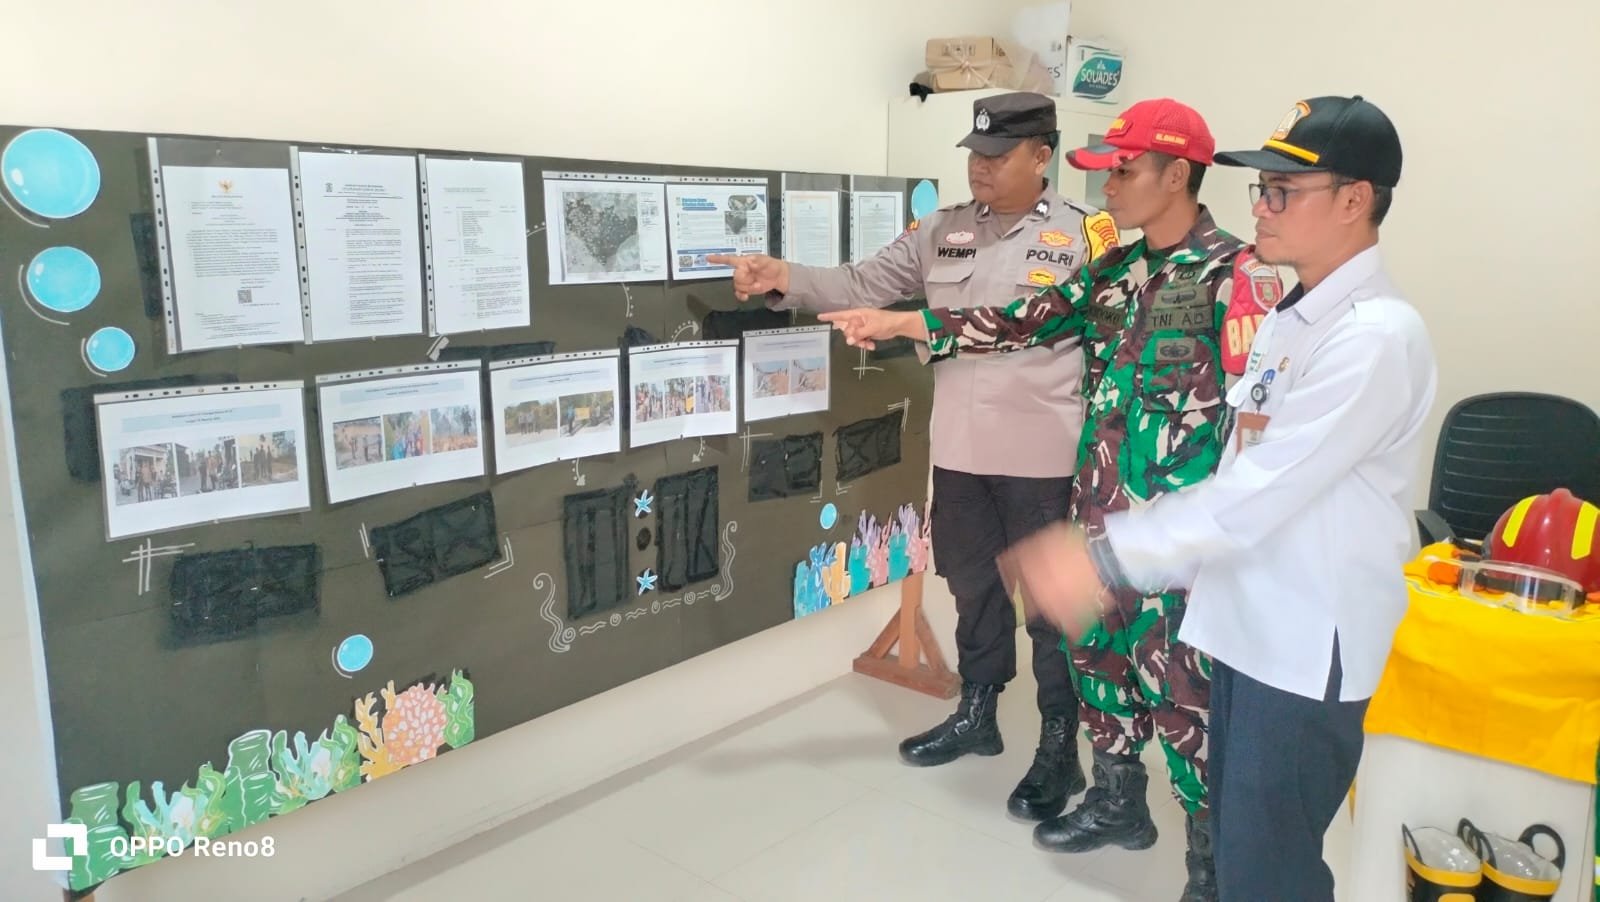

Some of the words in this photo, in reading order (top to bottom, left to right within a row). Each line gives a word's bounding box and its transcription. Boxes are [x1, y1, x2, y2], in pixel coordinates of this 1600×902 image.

[1081, 68, 1119, 86] SQUADES
[938, 247, 977, 259] WEMPI
[1026, 249, 1074, 266] POLRI
[1152, 313, 1173, 328] TNI
[1182, 312, 1205, 326] AD
